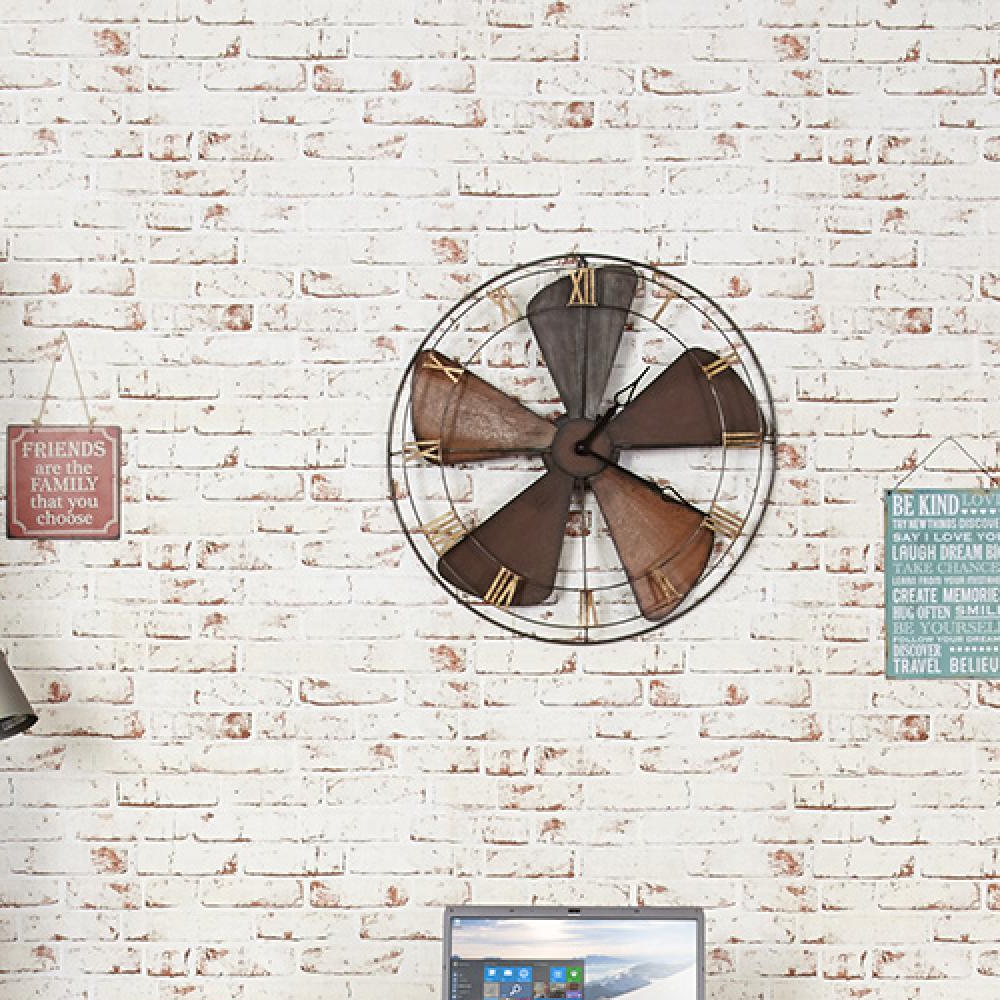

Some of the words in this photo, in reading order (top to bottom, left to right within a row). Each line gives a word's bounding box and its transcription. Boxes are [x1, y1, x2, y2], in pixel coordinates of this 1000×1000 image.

[567, 268, 598, 307] XII
[22, 441, 106, 458] FRIENDS
[35, 463, 62, 475] are
[66, 459, 93, 475] the
[30, 477, 99, 493] FAMILY
[31, 494, 63, 509] that
[67, 497, 99, 513] you
[892, 494, 914, 516] BE
[919, 494, 959, 516] KIND
[36, 510, 94, 525] choose
[893, 531, 920, 542] SAY
[924, 532, 929, 542] I
[933, 531, 973, 542] LOVE
[892, 544, 937, 560] LAUGH
[940, 544, 983, 560] DREAM
[892, 562, 933, 574] TAKE
[892, 588, 938, 603] CREATE
[917, 606, 951, 619] OFTEN
[893, 621, 915, 634] BE
[893, 644, 942, 657] DISCOVER
[894, 657, 942, 674] TRAVEL
